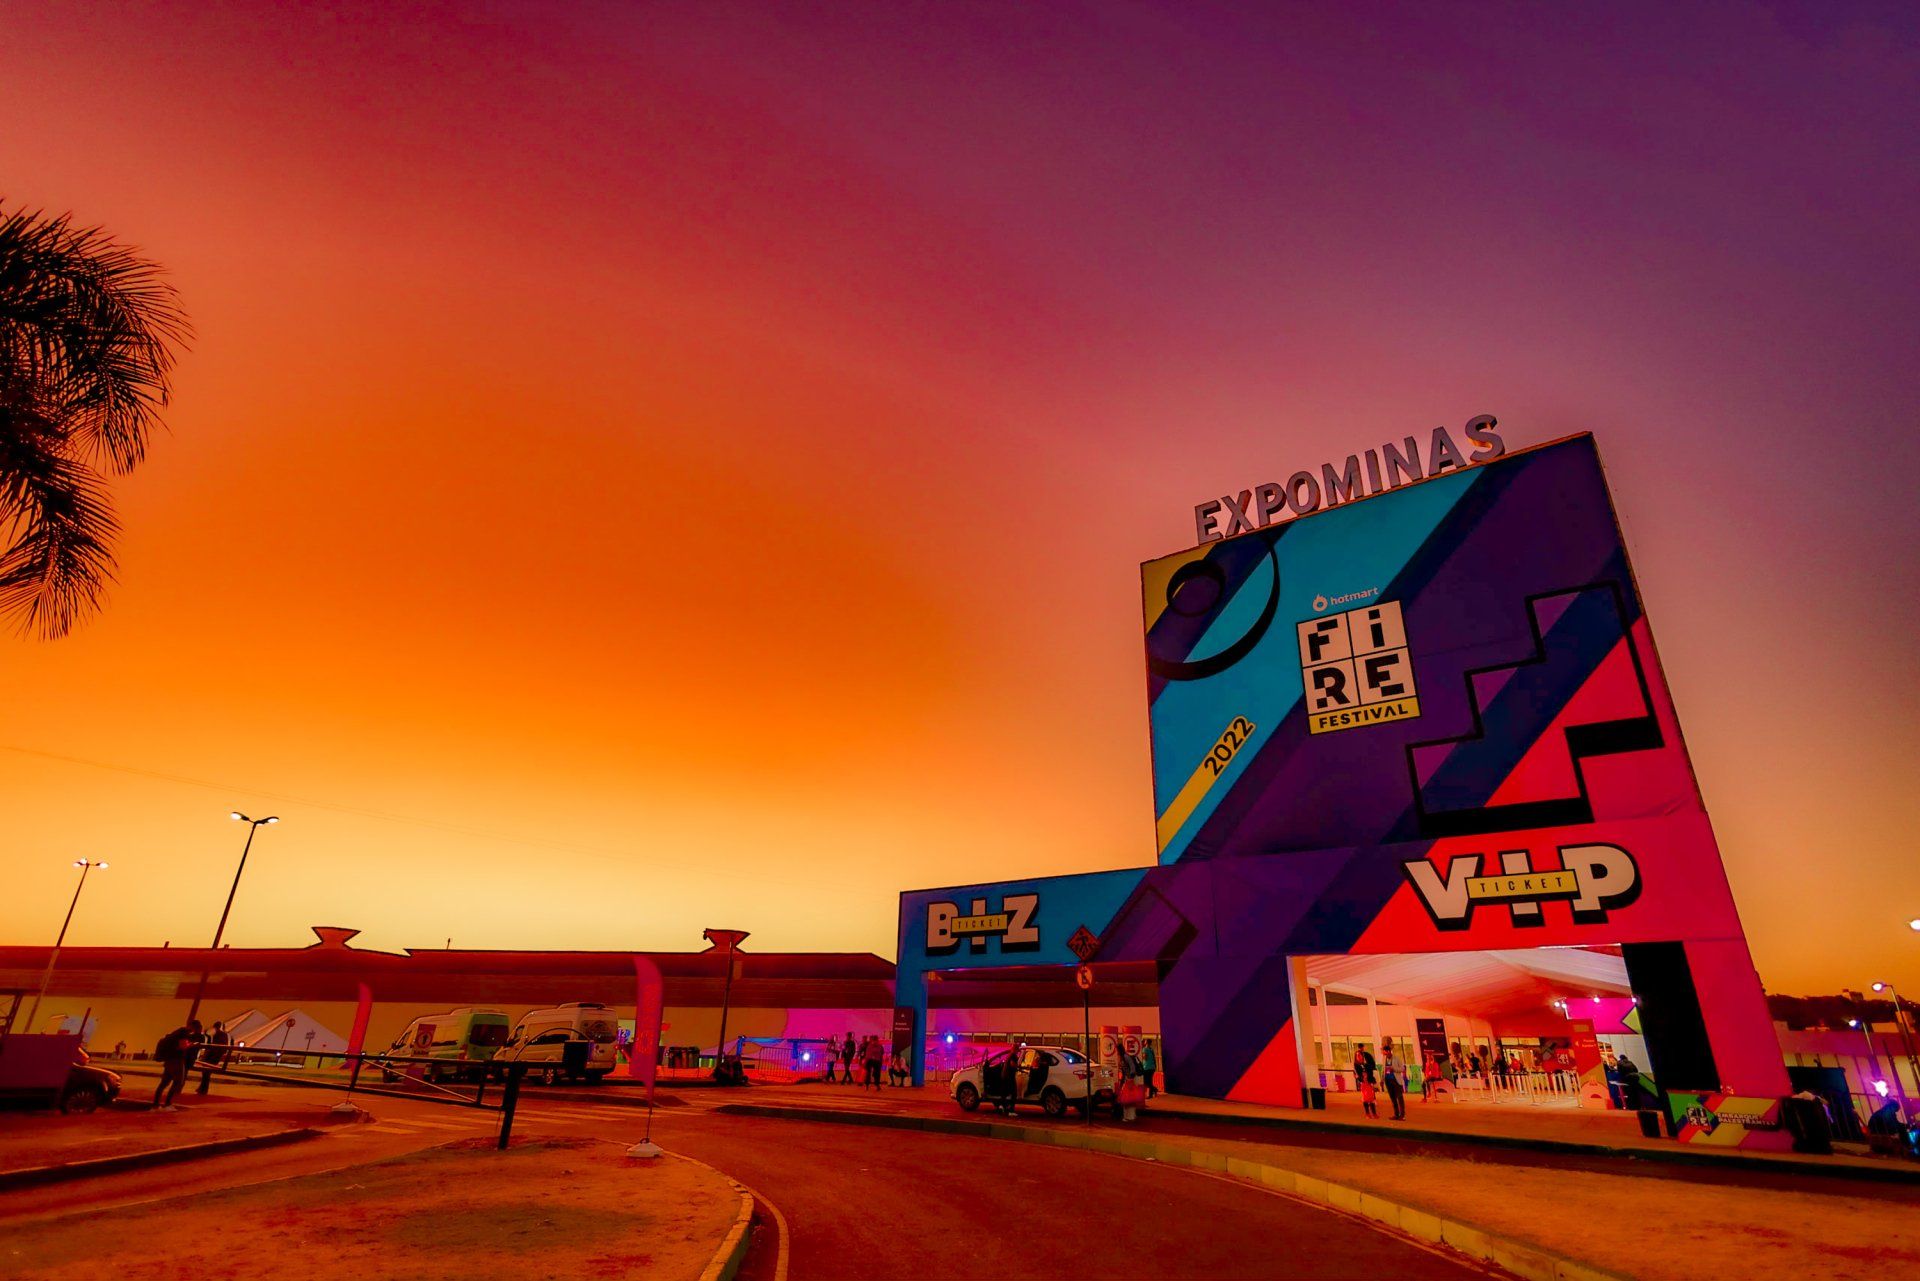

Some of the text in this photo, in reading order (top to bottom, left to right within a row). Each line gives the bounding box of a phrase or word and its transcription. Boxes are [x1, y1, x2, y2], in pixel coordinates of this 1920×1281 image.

[1194, 414, 1506, 546] EXPOMINAS
[1330, 587, 1379, 605] hotmart
[1318, 704, 1409, 729] FESTIVAL
[1204, 718, 1254, 777] 2022
[1403, 843, 1640, 929] VIP
[1480, 877, 1563, 893] TICKET
[926, 893, 1040, 954] BIZ
[958, 918, 1001, 929] TICKET
